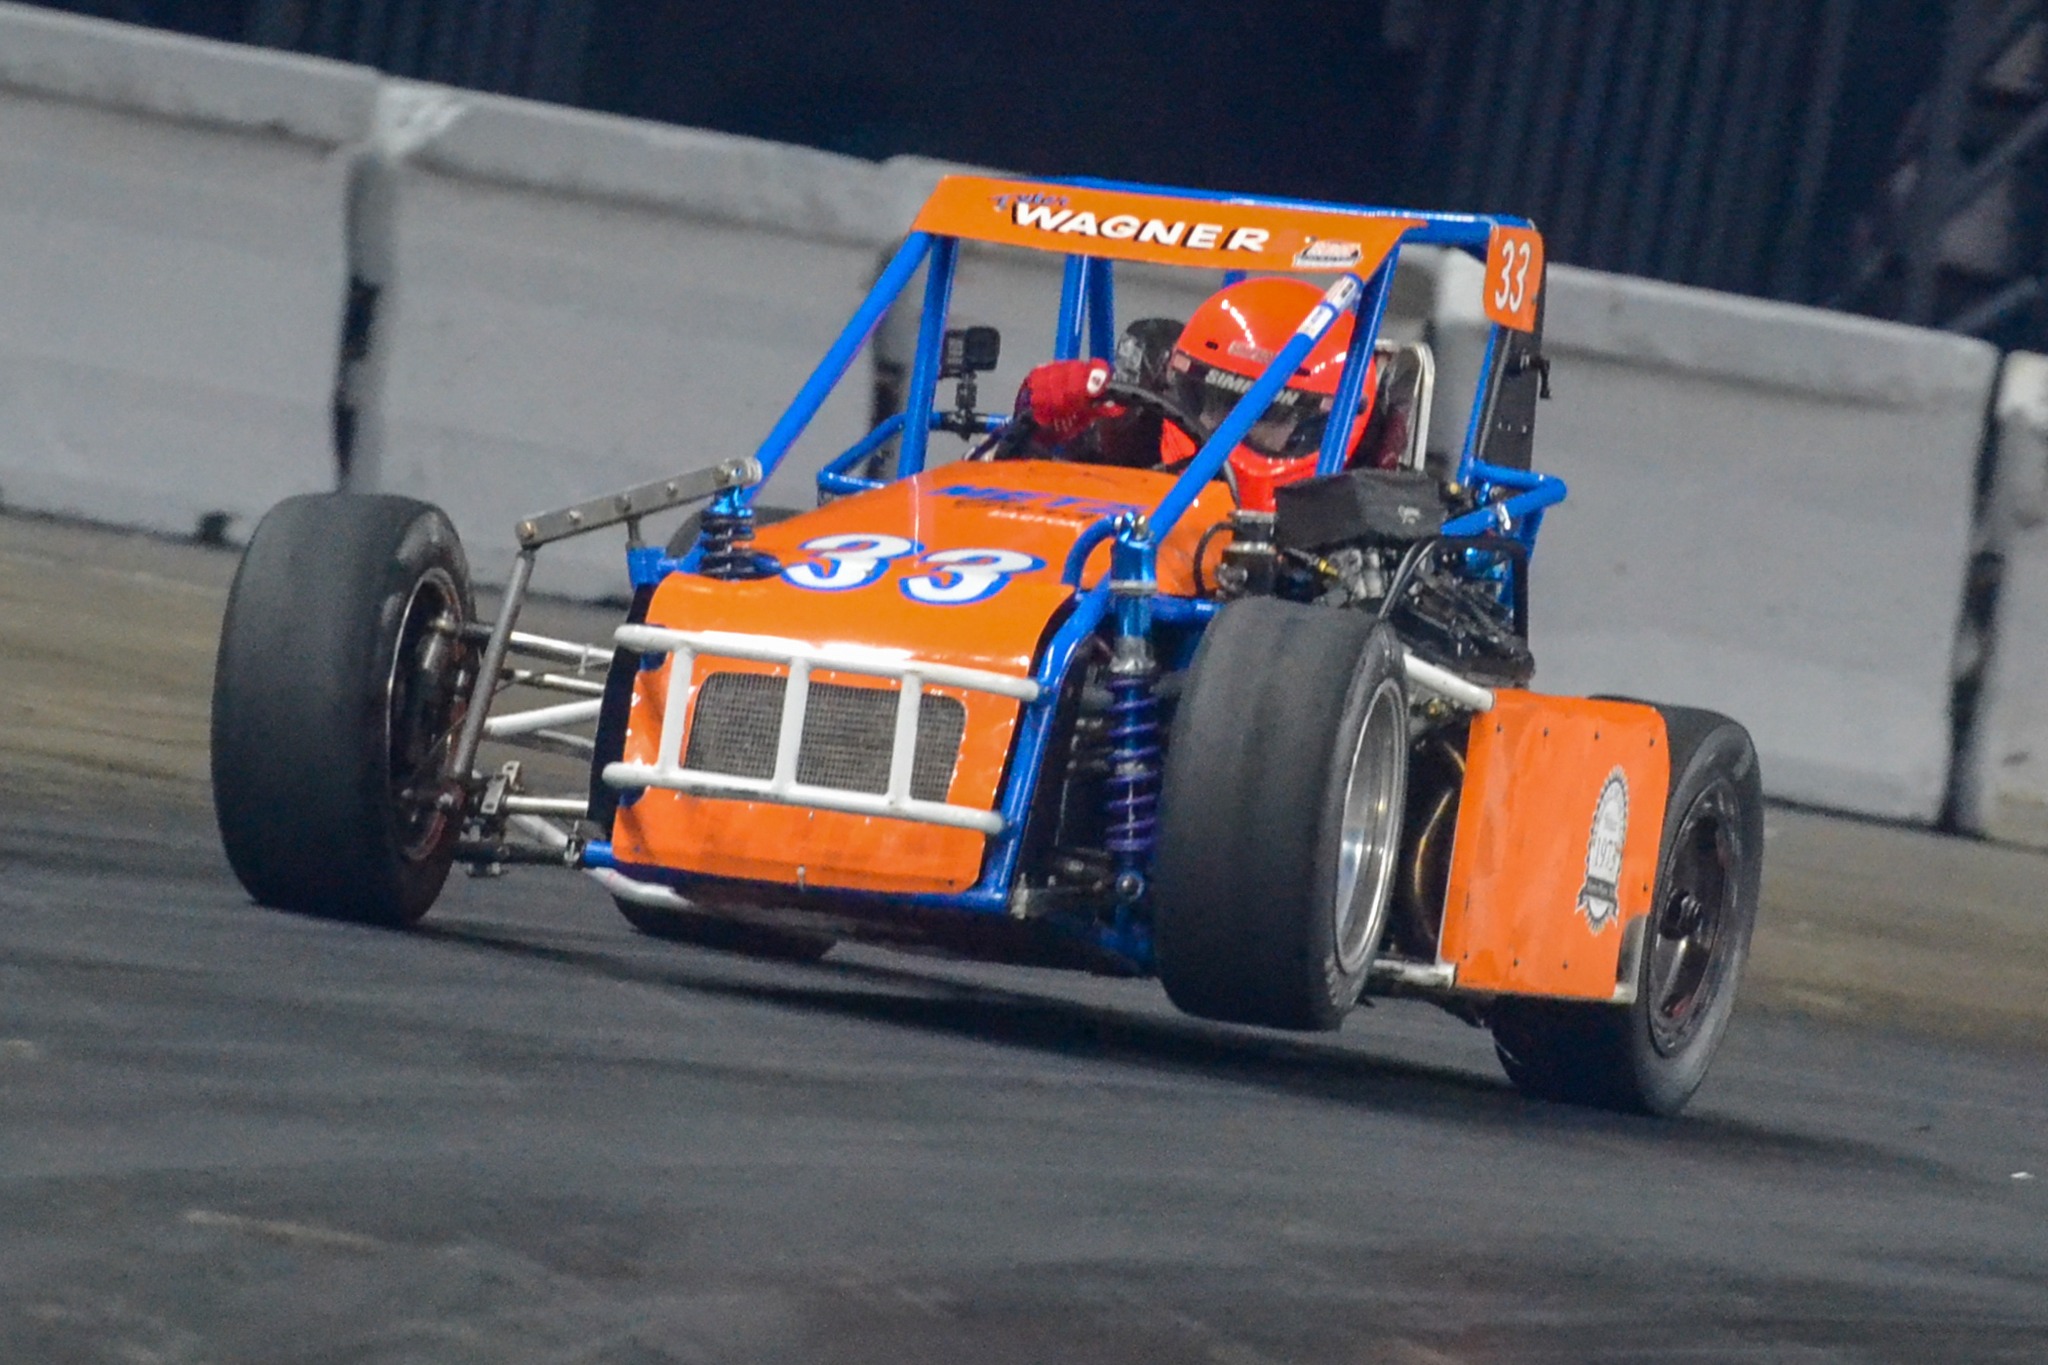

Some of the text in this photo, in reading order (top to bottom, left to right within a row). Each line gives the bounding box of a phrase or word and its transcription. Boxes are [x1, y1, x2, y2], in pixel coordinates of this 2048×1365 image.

[1012, 203, 1269, 251] WAGNER
[1495, 238, 1531, 314] 33
[779, 533, 1047, 605] 33
